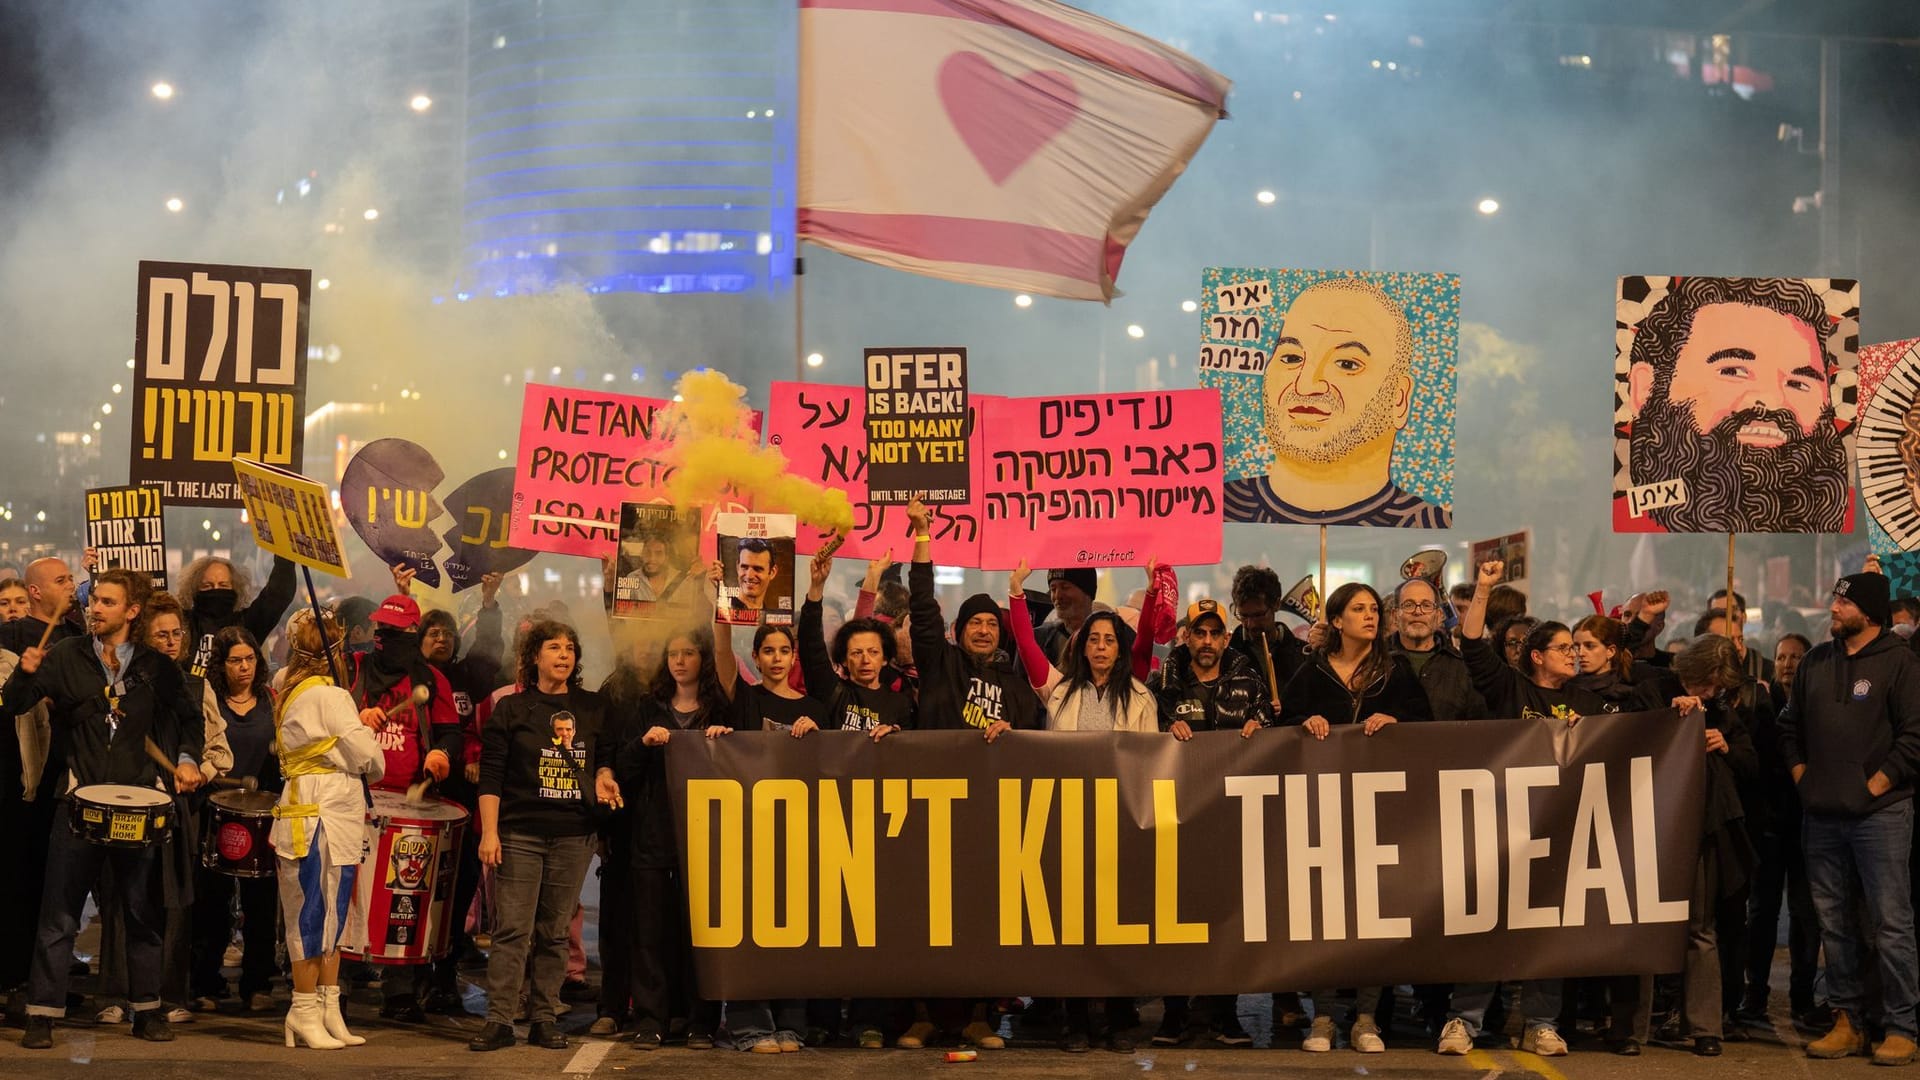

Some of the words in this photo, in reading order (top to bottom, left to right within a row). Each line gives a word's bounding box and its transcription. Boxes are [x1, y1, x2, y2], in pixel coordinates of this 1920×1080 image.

[1220, 285, 1268, 306] יאיר
[145, 272, 299, 385] כולם
[1213, 316, 1260, 338] חזר
[1200, 347, 1265, 371] הביתה
[867, 354, 963, 390] OFER
[868, 392, 890, 415] IS
[895, 391, 963, 414] BACK!
[142, 387, 295, 465] עכשיו!
[869, 419, 906, 438] TOO
[909, 419, 964, 439] MANY
[1039, 395, 1172, 439] עדיפים
[870, 441, 912, 464] NOT
[916, 440, 965, 463] YET!
[1125, 442, 1217, 476] כאבי
[993, 448, 1112, 491] העסקה
[177, 482, 199, 498] THE
[201, 483, 232, 500] LAST
[871, 490, 892, 501] UNTIL
[894, 490, 909, 501] THE
[929, 489, 966, 501] HOSTAGE!
[1631, 483, 1679, 515] איתן
[88, 487, 161, 521] נלחמים
[89, 519, 136, 547] אחרון
[138, 517, 162, 543] עד
[616, 589, 631, 600] HIM
[618, 577, 639, 590] BRING
[984, 682, 1002, 702] MY
[113, 822, 138, 831] THEM
[114, 814, 143, 822] BRING
[111, 832, 137, 840] HOME
[687, 778, 968, 948] DON'T
[999, 778, 1209, 946] KILL
[1224, 770, 1412, 943] THE
[1438, 756, 1690, 936] DEAL
